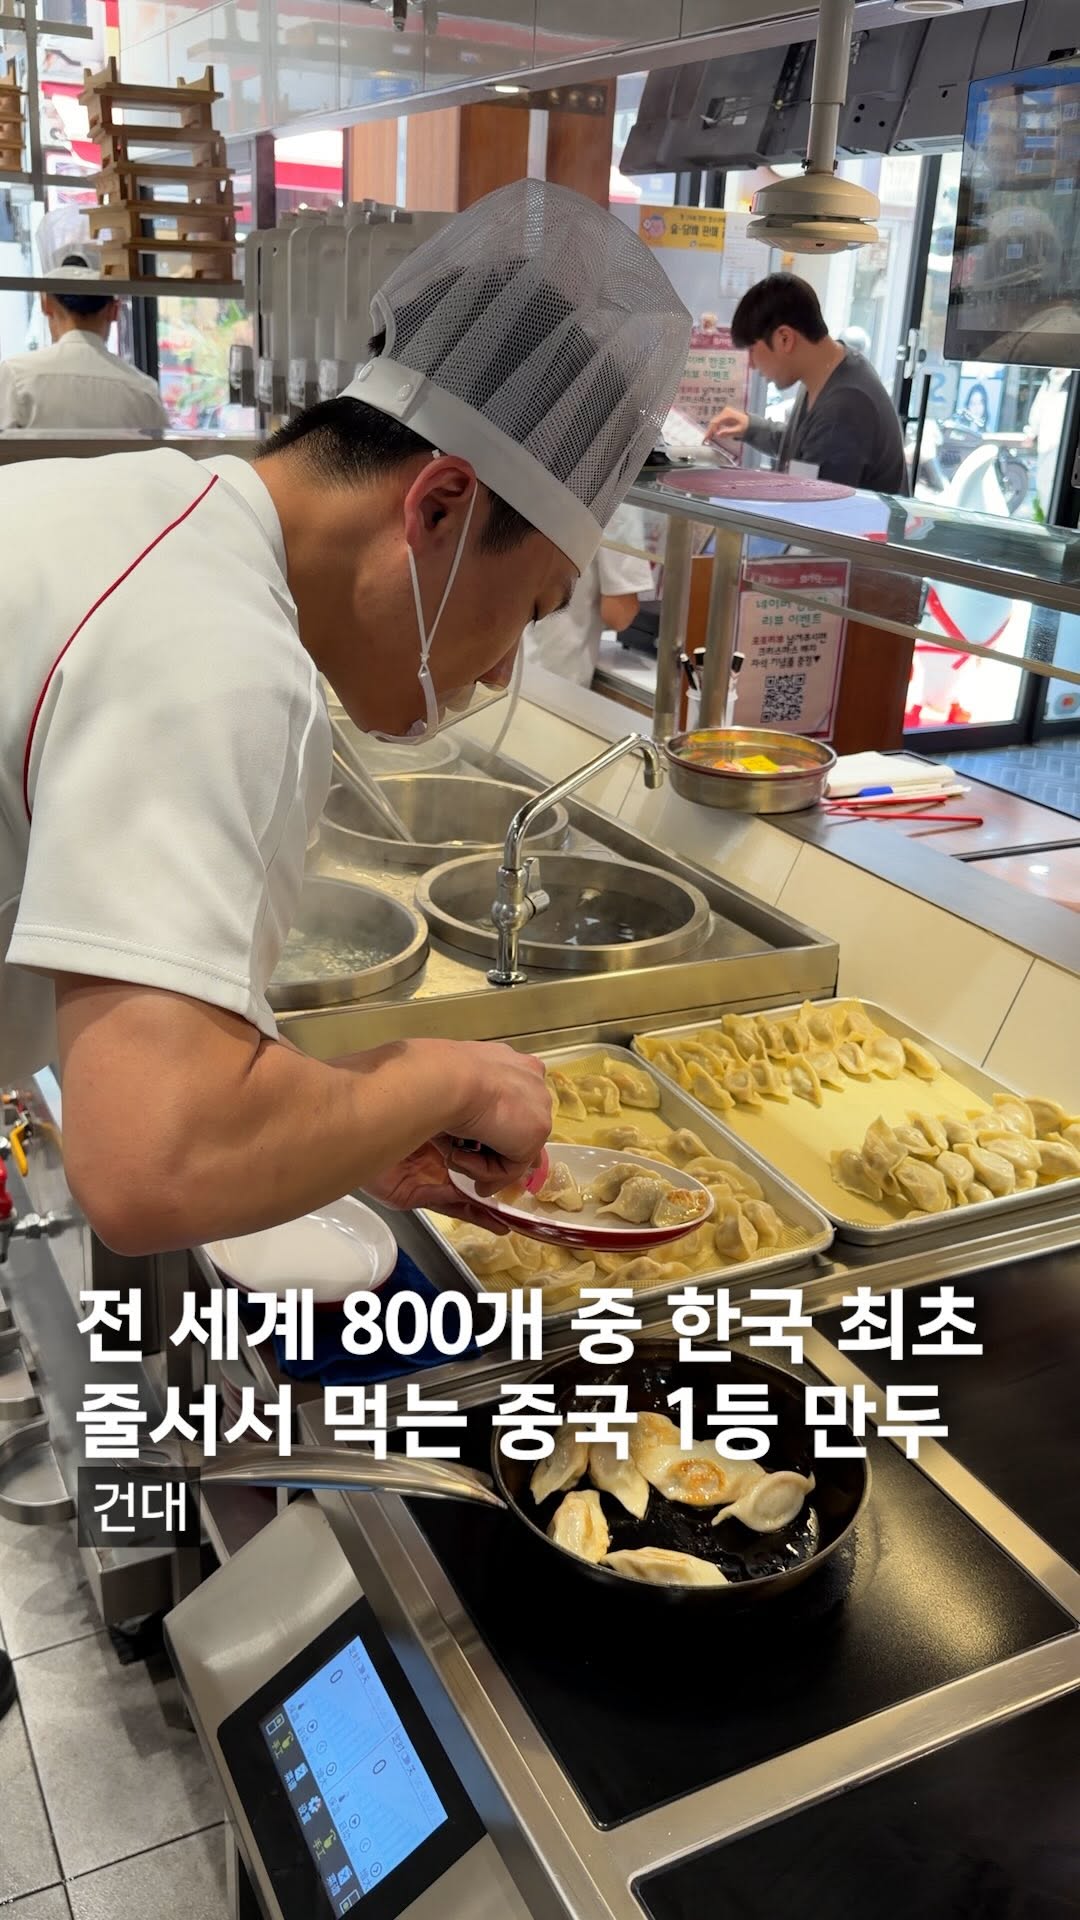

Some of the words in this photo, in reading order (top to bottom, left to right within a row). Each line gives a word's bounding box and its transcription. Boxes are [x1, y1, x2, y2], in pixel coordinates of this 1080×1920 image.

[756, 598, 791, 610] 네이버
[761, 614, 784, 626] 리뷰
[788, 613, 822, 628] 이벤트
